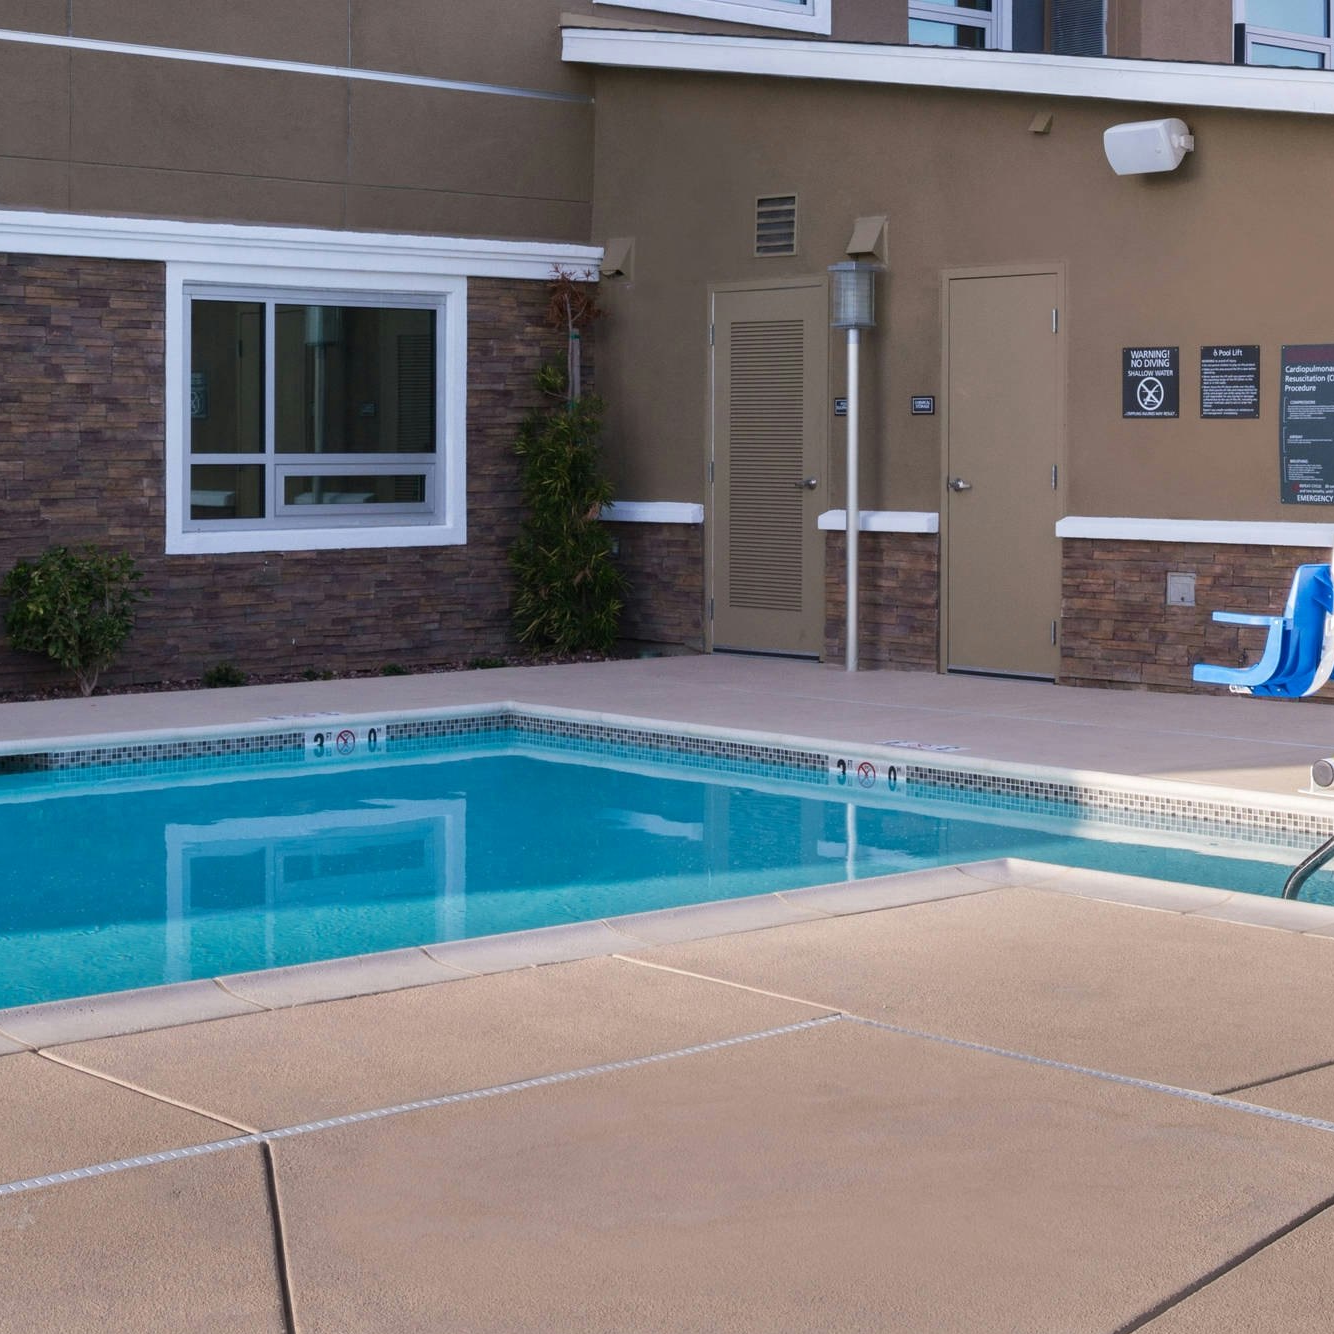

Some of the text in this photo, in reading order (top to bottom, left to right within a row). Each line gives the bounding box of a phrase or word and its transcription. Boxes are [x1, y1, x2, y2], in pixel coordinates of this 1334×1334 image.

[1130, 349, 1170, 359] WARNING!
[1218, 349, 1231, 357] Pool
[1130, 359, 1170, 368] NO DIVING
